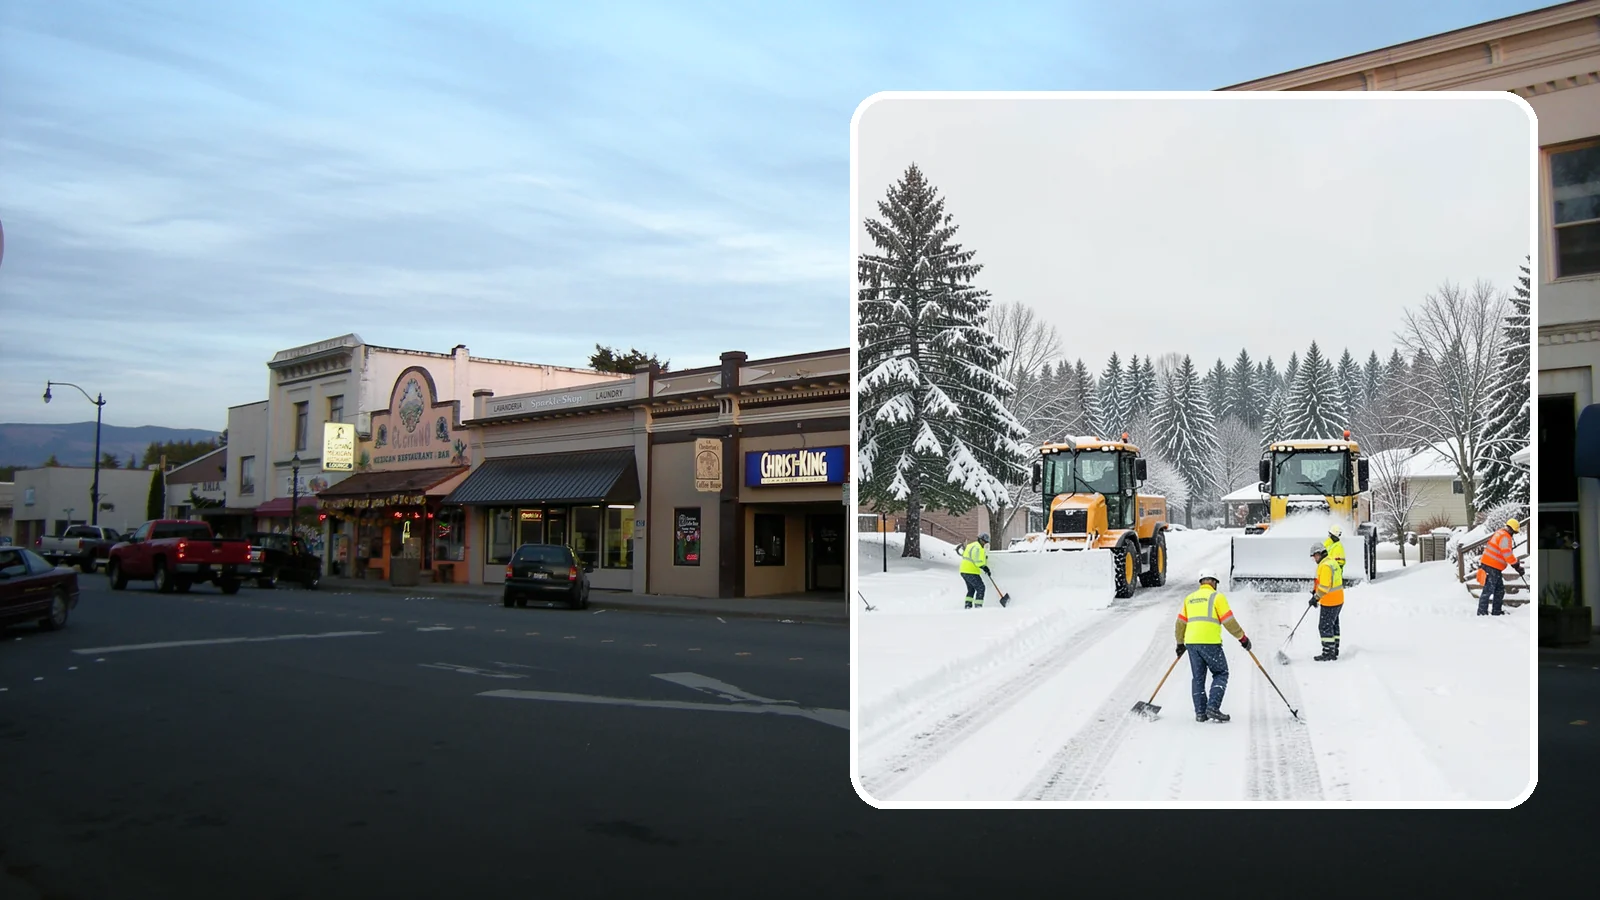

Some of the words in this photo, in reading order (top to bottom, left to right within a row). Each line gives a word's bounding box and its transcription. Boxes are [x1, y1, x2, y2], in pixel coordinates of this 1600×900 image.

[596, 389, 623, 399] LAUNDRY
[494, 403, 522, 412] LAVANDERIA
[531, 396, 561, 408] Sparkle
[562, 395, 582, 404] Shop
[374, 455, 396, 463] MEXICAN
[398, 451, 433, 462] RESTAURANT
[438, 450, 450, 459] BAR
[761, 452, 797, 478] CHRIST
[799, 450, 827, 476] KING
